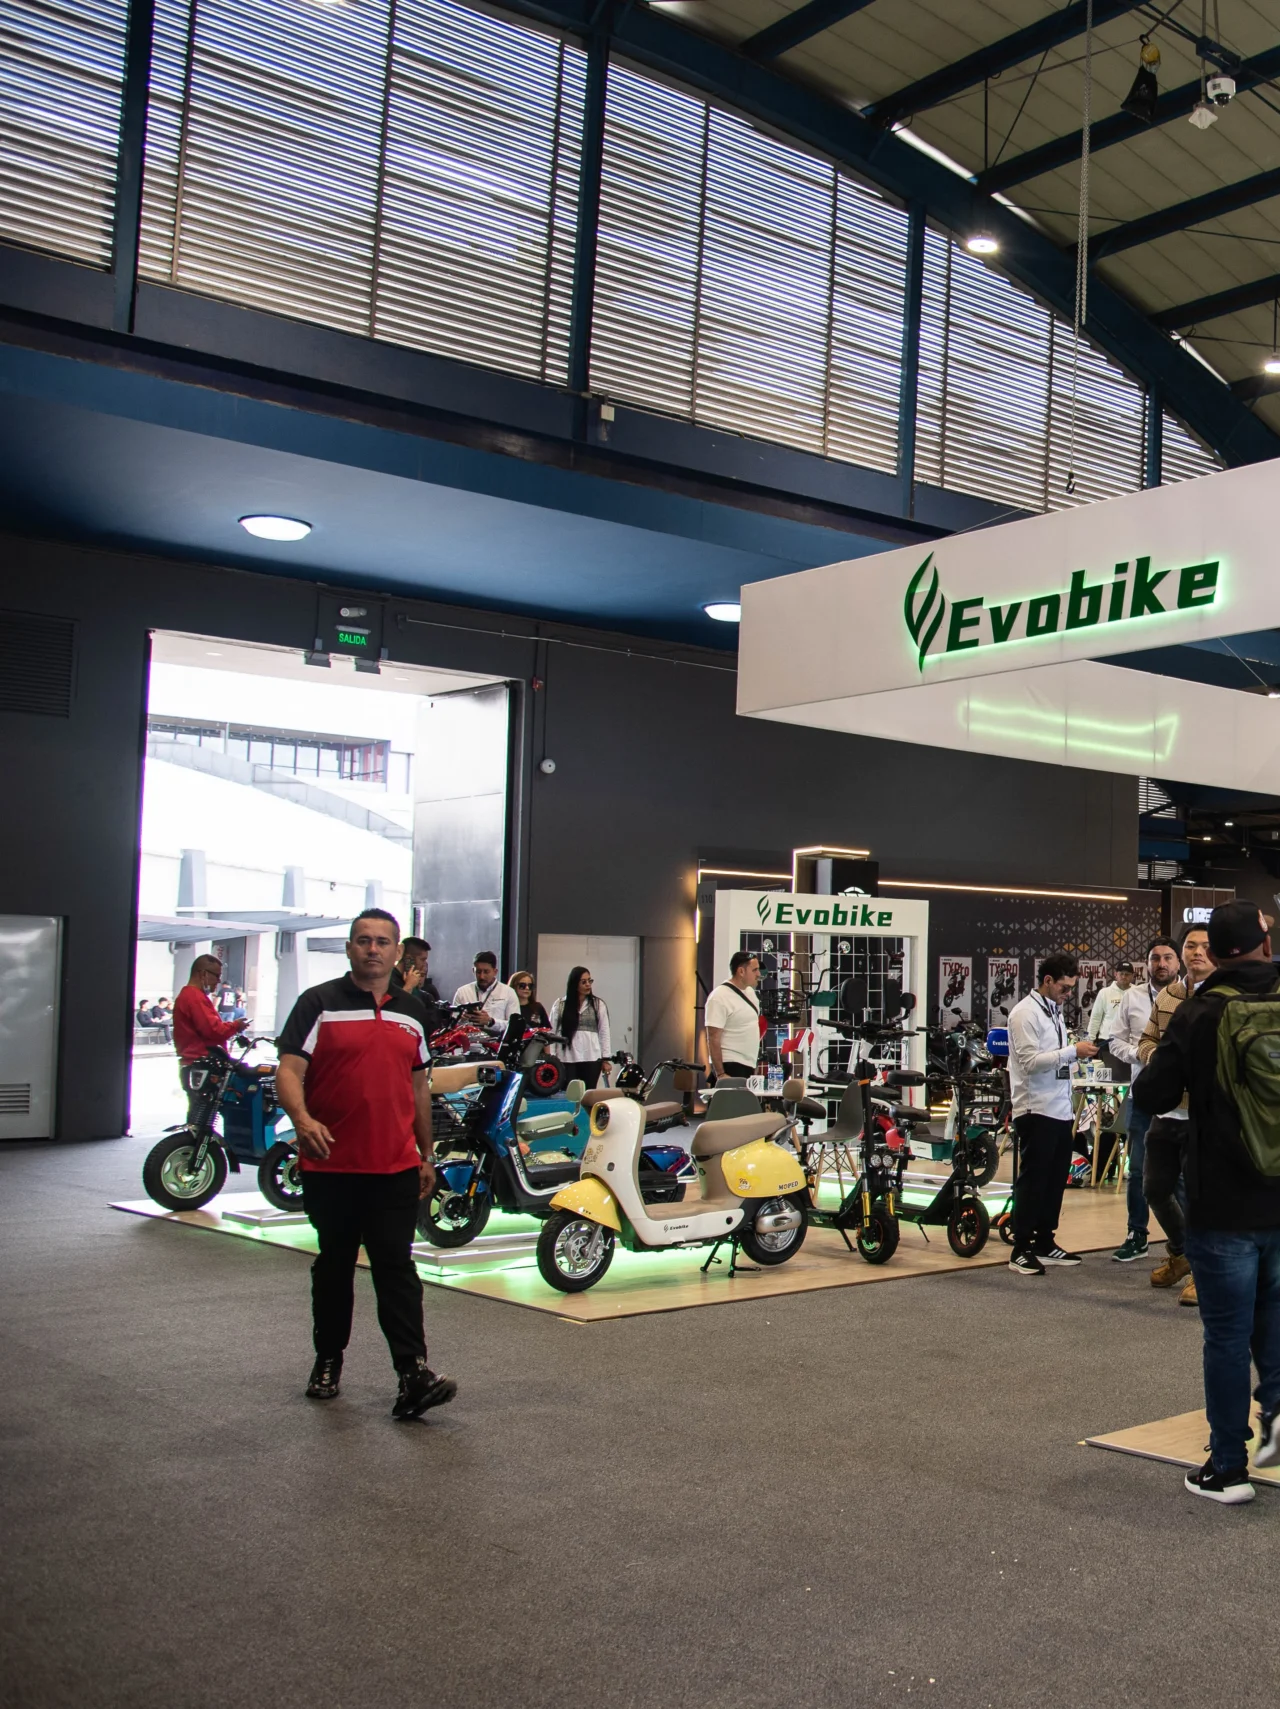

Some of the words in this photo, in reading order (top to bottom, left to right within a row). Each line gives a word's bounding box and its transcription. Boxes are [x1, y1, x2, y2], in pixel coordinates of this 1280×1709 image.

[946, 556, 1220, 653] Evobike
[339, 633, 366, 646] SALIDA
[775, 903, 893, 927] Evobike
[778, 1181, 799, 1191] MOPED
